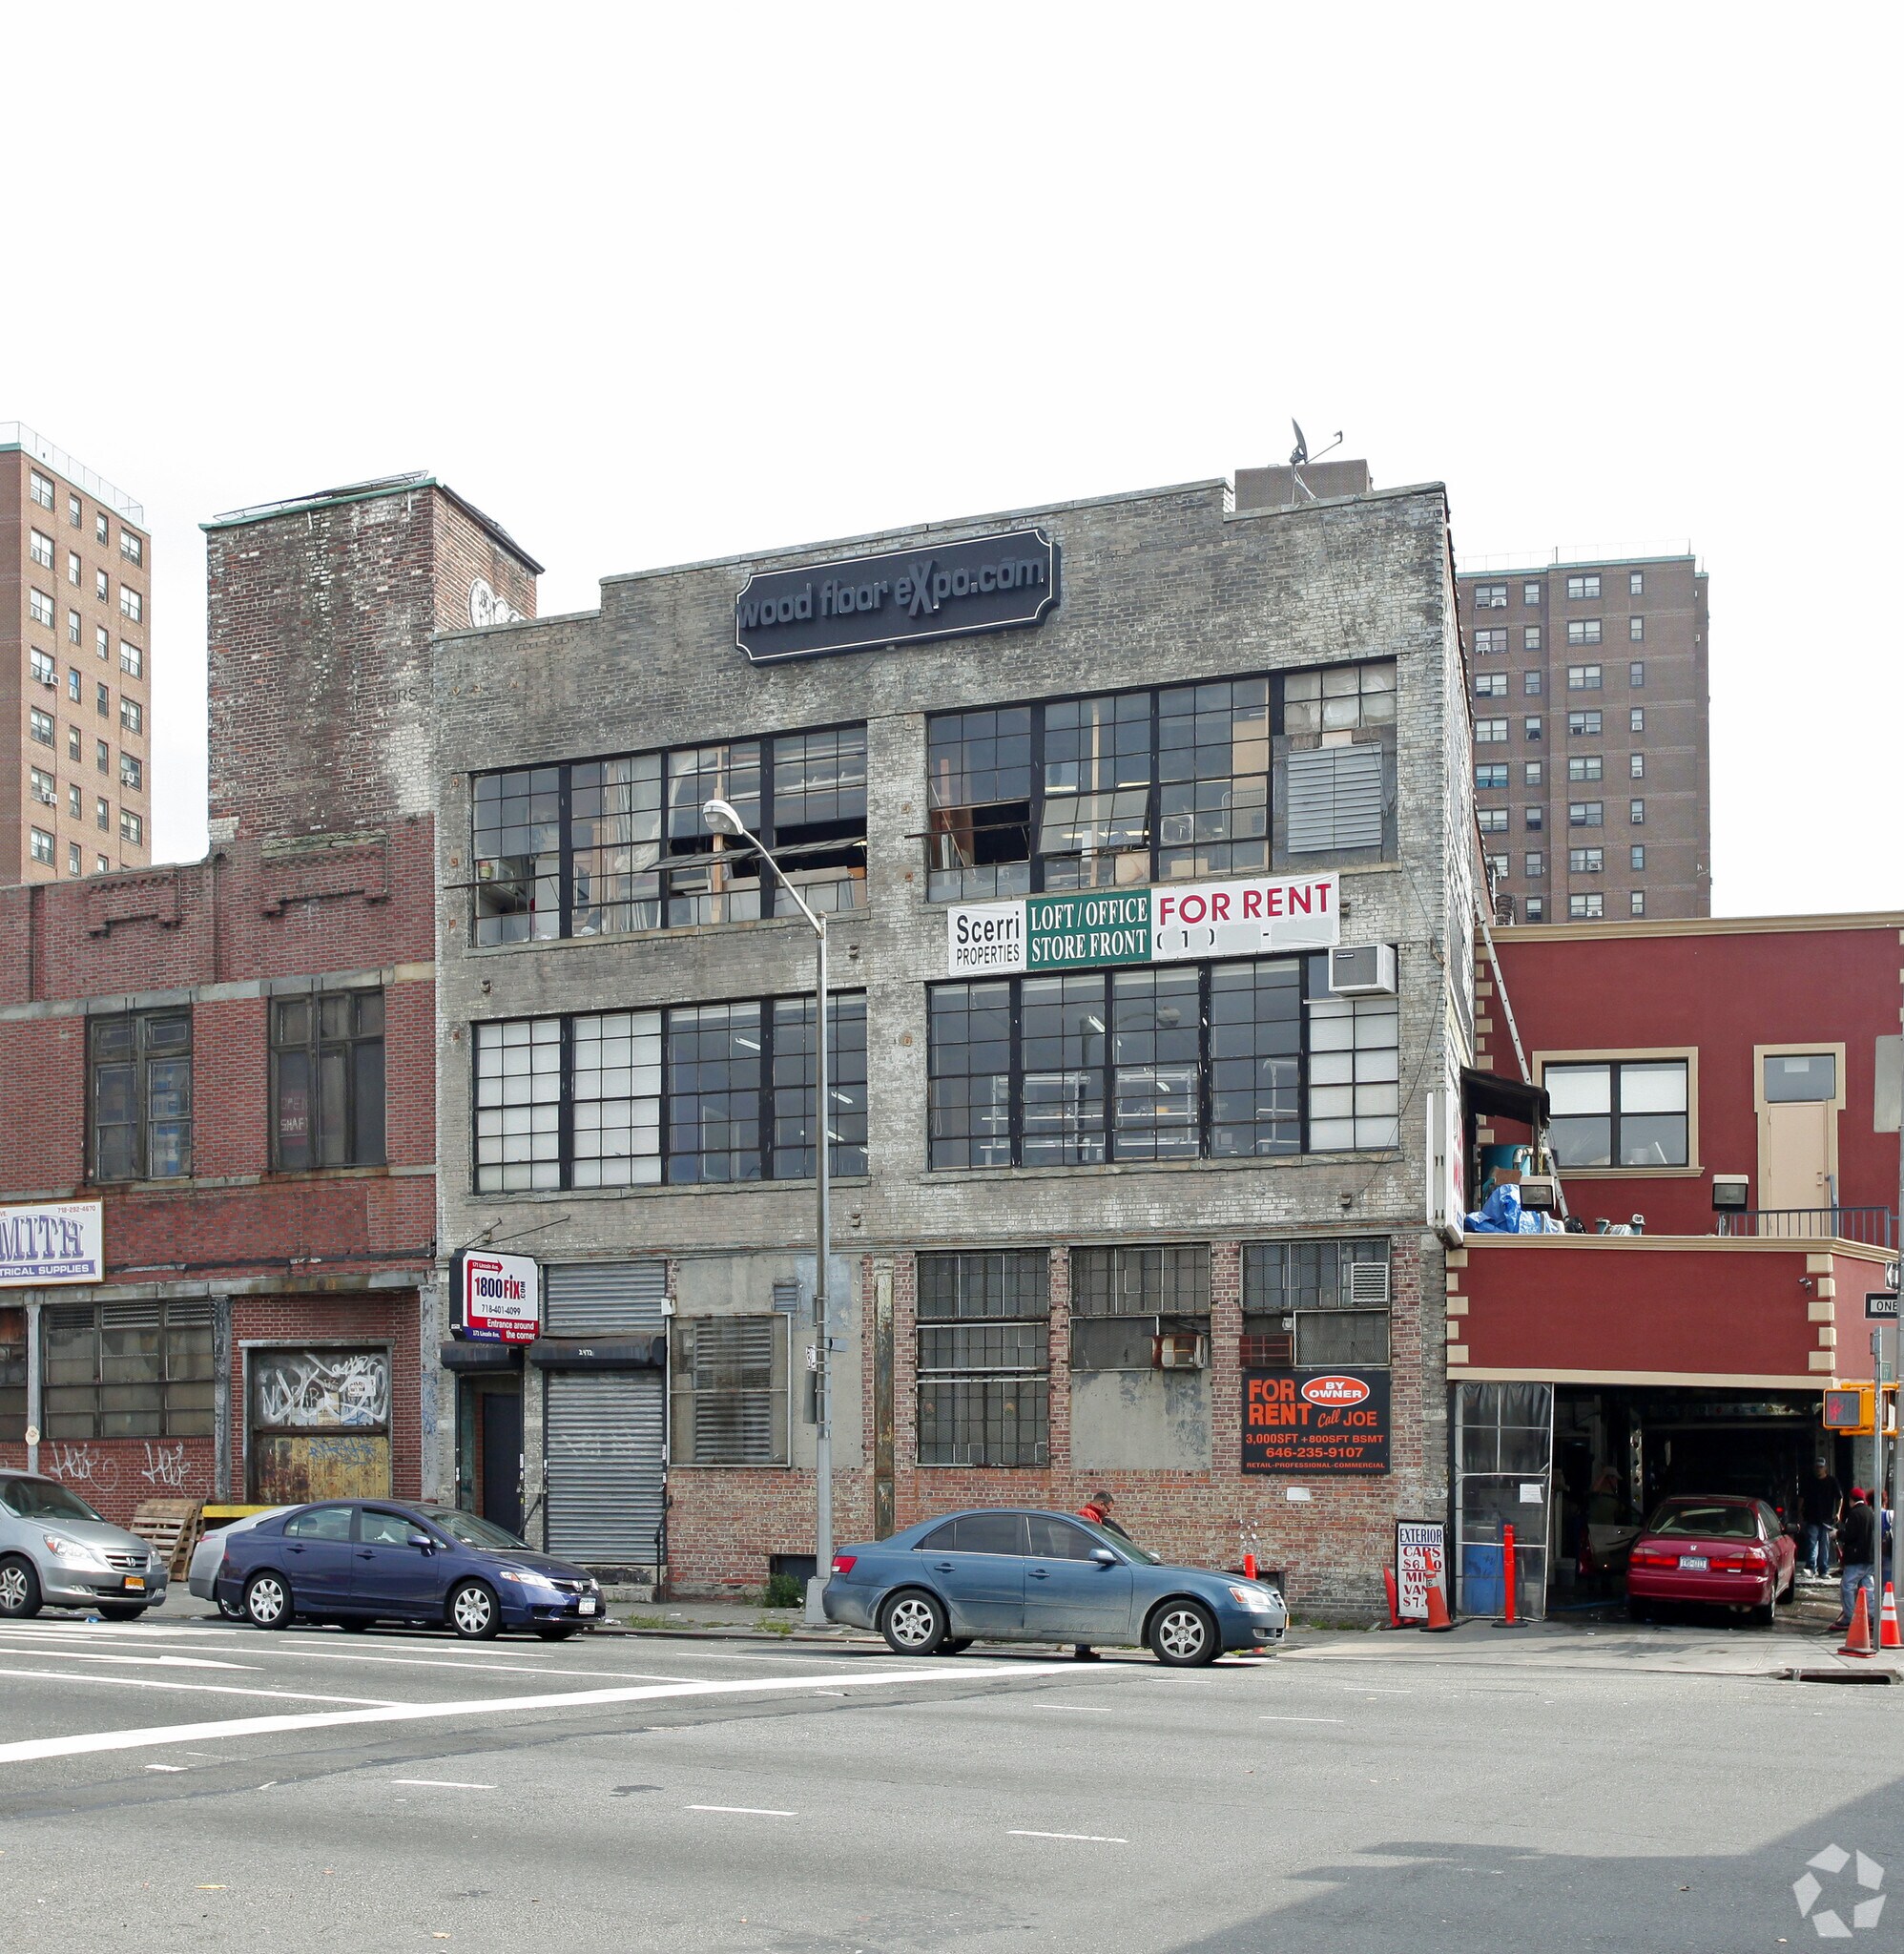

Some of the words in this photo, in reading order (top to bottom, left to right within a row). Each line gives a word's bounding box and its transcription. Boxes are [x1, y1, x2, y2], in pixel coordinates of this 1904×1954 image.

[738, 583, 812, 629] wood
[820, 579, 888, 616] floor
[1160, 892, 1230, 925] FOR
[1244, 883, 1332, 919] RENT
[1030, 904, 1075, 931] LOFT
[1085, 897, 1148, 925] OFFICE
[957, 911, 1020, 944] Scerri
[1031, 933, 1086, 962] STORE
[1089, 929, 1147, 958] FRONT
[957, 944, 1020, 966] PROPERTIES
[38, 1264, 90, 1275] SUPPLIES
[481, 1304, 521, 1316] 718-401-4099
[487, 1319, 512, 1328] Entrance
[514, 1321, 534, 1330] around
[506, 1330, 515, 1339] the
[1249, 1380, 1295, 1402] FOR
[1309, 1390, 1362, 1399] OWNER
[1249, 1403, 1313, 1425] RENT
[1317, 1408, 1341, 1428] Call
[1343, 1411, 1377, 1426] JOE
[1246, 1433, 1298, 1445] 3,000SFT
[1353, 1435, 1384, 1444] BSMT
[1266, 1447, 1364, 1458] 646-235-9107
[1400, 1528, 1442, 1543] EXTERIOR
[1403, 1559, 1442, 1570] $6.0
[1403, 1596, 1428, 1608] $7.
